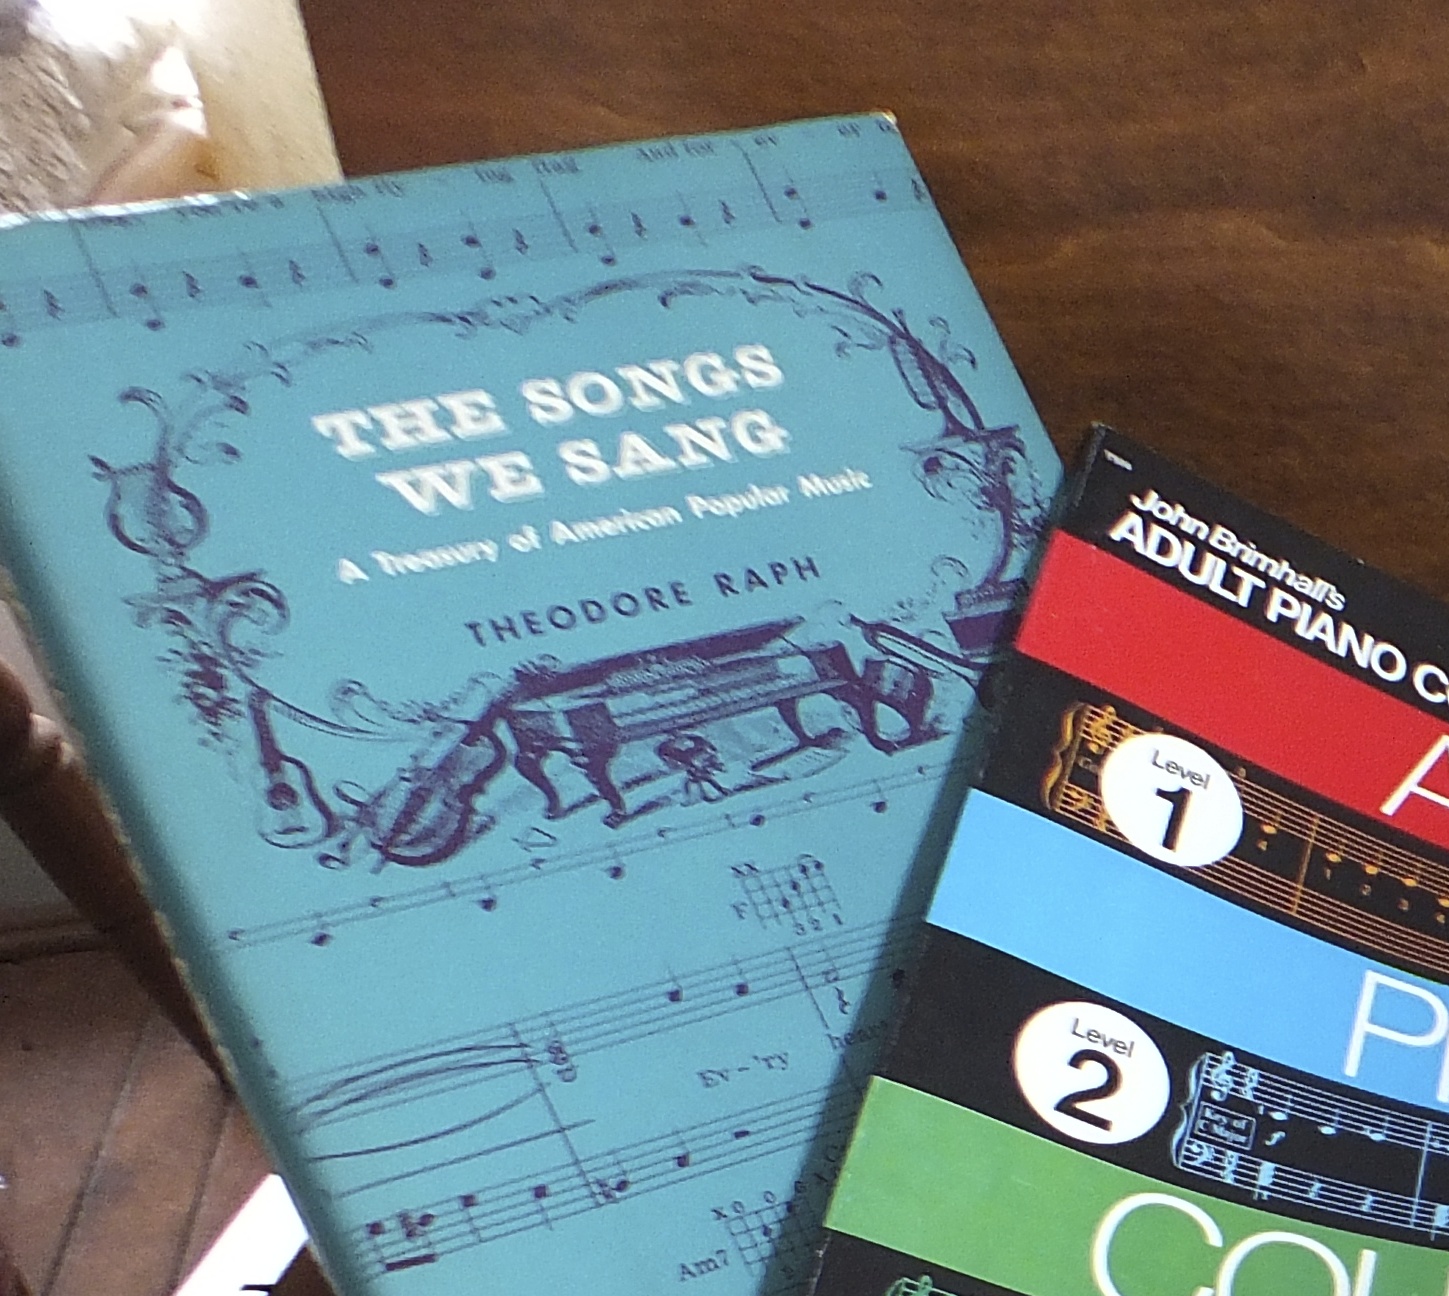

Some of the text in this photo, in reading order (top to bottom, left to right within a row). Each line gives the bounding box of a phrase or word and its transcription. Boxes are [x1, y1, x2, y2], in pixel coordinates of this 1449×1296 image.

[310, 344, 785, 461] THE SONGS
[375, 408, 791, 516] WE SANG
[337, 466, 873, 585] A Treasury of American Popular Music
[1129, 489, 1346, 612] John Brimhall's
[465, 554, 823, 648] THEODORE RAPH
[1109, 510, 1266, 608] ADULT
[1265, 586, 1408, 684] PIANO
[1152, 749, 1211, 790] Level
[1155, 786, 1193, 853] 1
[1072, 1016, 1135, 1060] Level
[1052, 1047, 1125, 1133] 2
[677, 1249, 731, 1283] Am7
